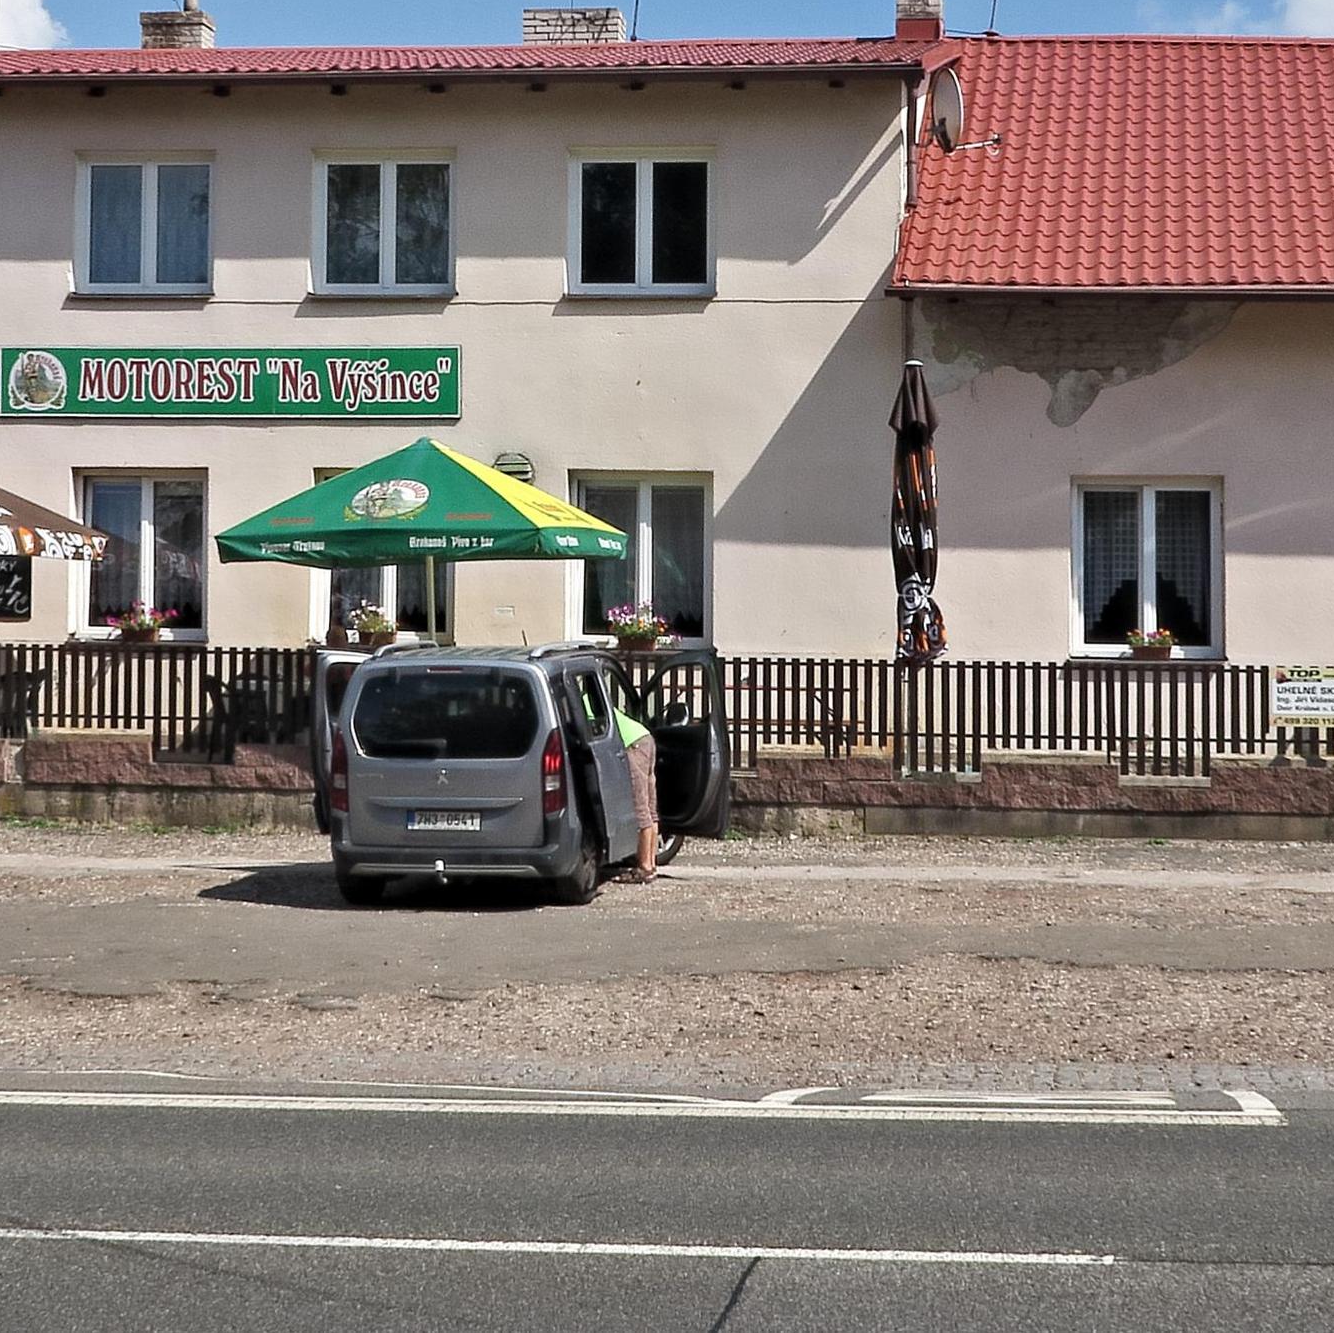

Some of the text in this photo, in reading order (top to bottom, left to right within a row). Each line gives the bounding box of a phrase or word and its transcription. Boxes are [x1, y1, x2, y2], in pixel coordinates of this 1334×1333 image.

[79, 358, 260, 402] MOTOREST
[267, 358, 321, 403] "Na
[329, 358, 452, 412] Výšince"
[1288, 669, 1320, 678] TOP
[1276, 686, 1317, 695] UHELNÉ
[446, 813, 475, 827] 0541
